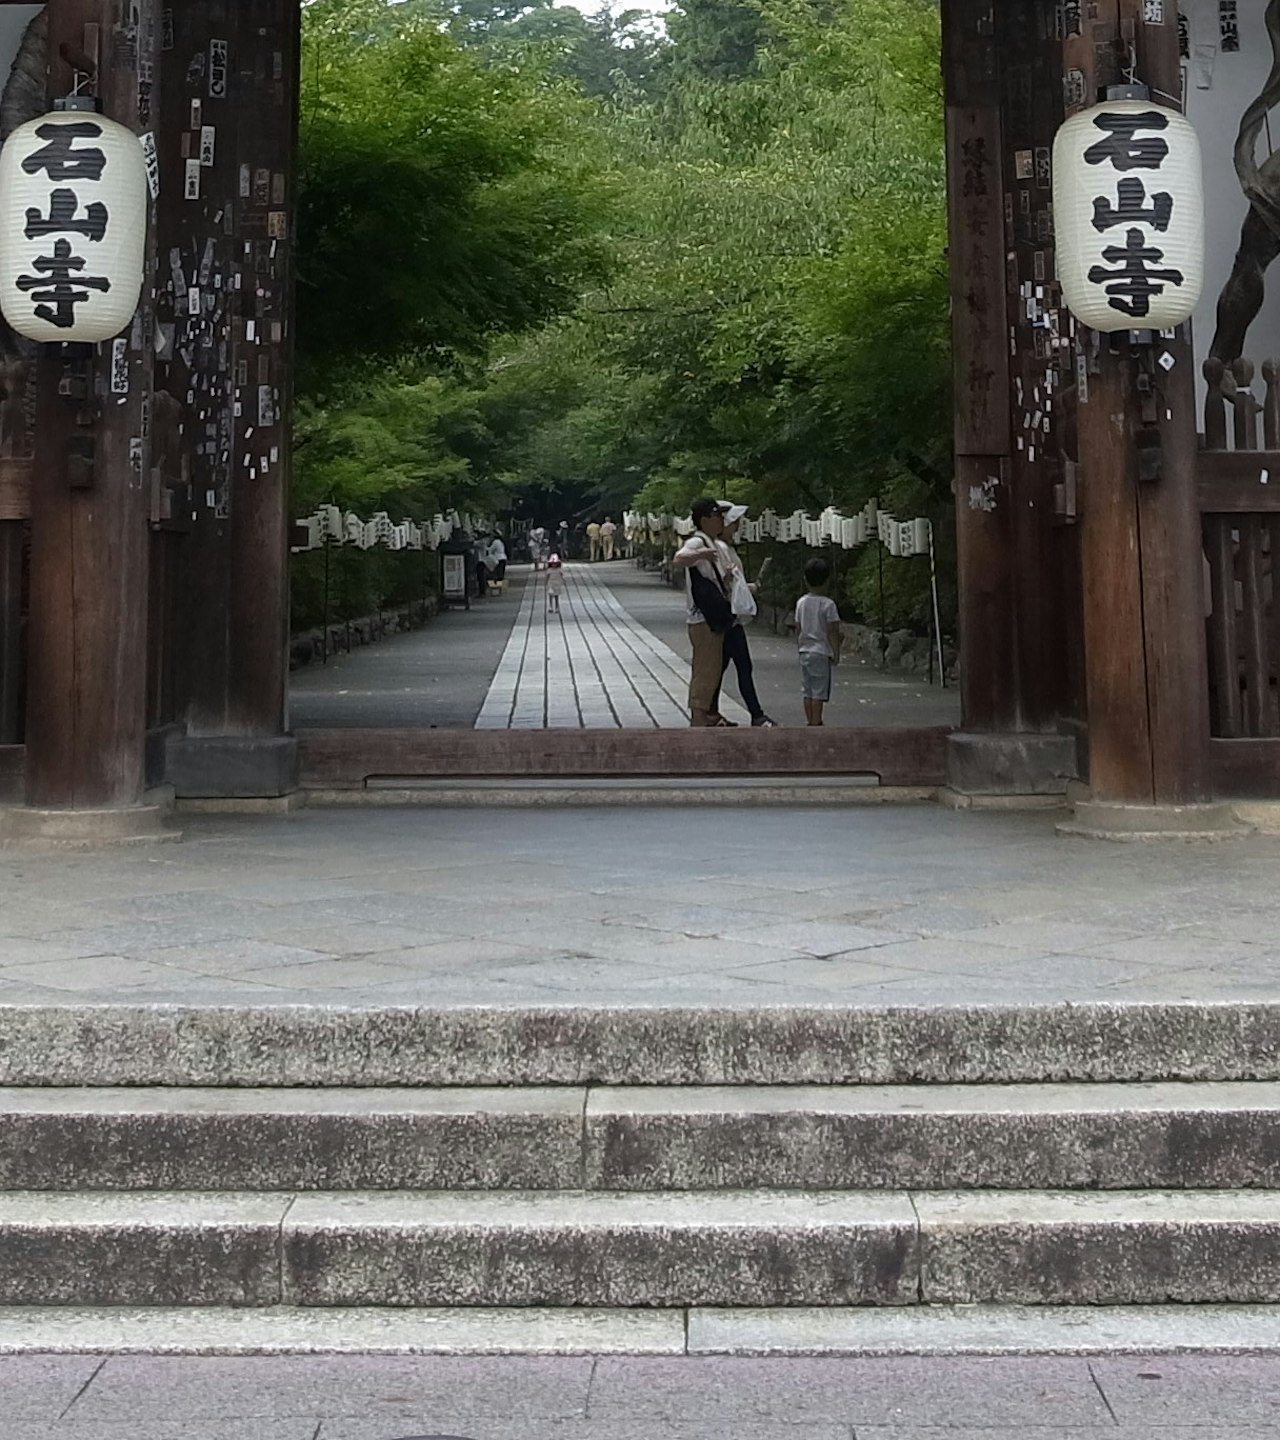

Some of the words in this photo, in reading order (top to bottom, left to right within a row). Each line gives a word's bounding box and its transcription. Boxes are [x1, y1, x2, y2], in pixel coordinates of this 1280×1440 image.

[16, 122, 111, 328] 石山寺
[1083, 111, 1184, 317] 石山寺
